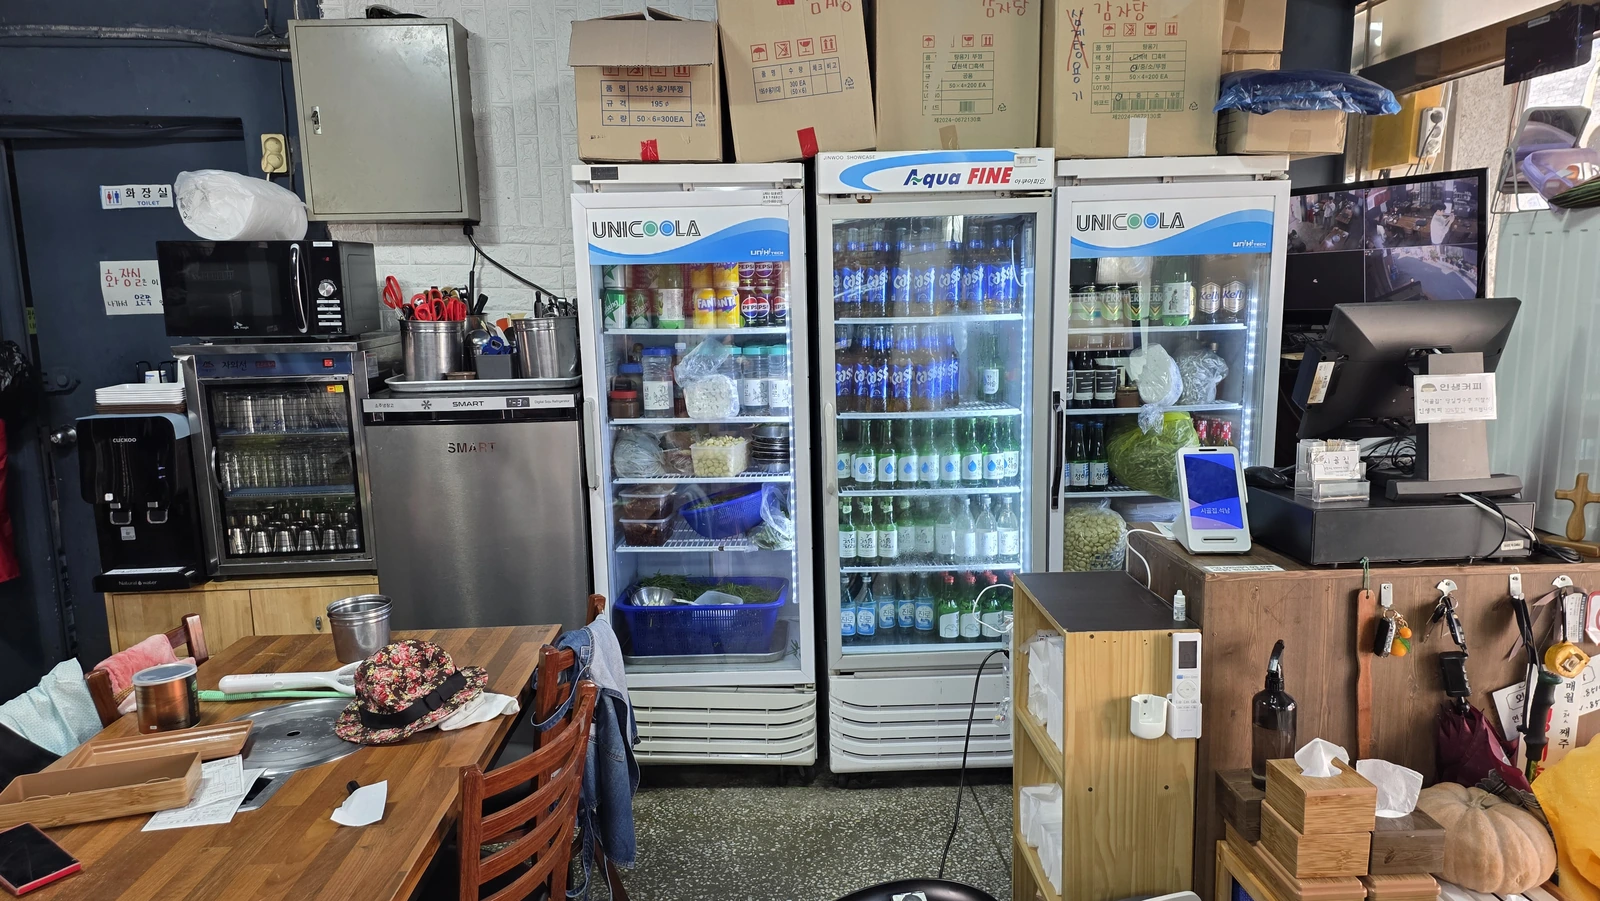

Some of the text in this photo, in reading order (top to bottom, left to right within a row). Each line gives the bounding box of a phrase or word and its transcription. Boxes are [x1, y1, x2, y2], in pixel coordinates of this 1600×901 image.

[657, 85, 684, 93] 용기뚜껑
[606, 99, 627, 107] 규격
[903, 167, 1014, 189] Aqua FINE
[125, 187, 168, 199] 화장실
[1076, 212, 1185, 232] UNICOOLA
[592, 220, 702, 238] UNICOOLA
[222, 360, 247, 371] 자외선
[1439, 382, 1482, 391] 인생커피
[447, 442, 496, 453] SMART
